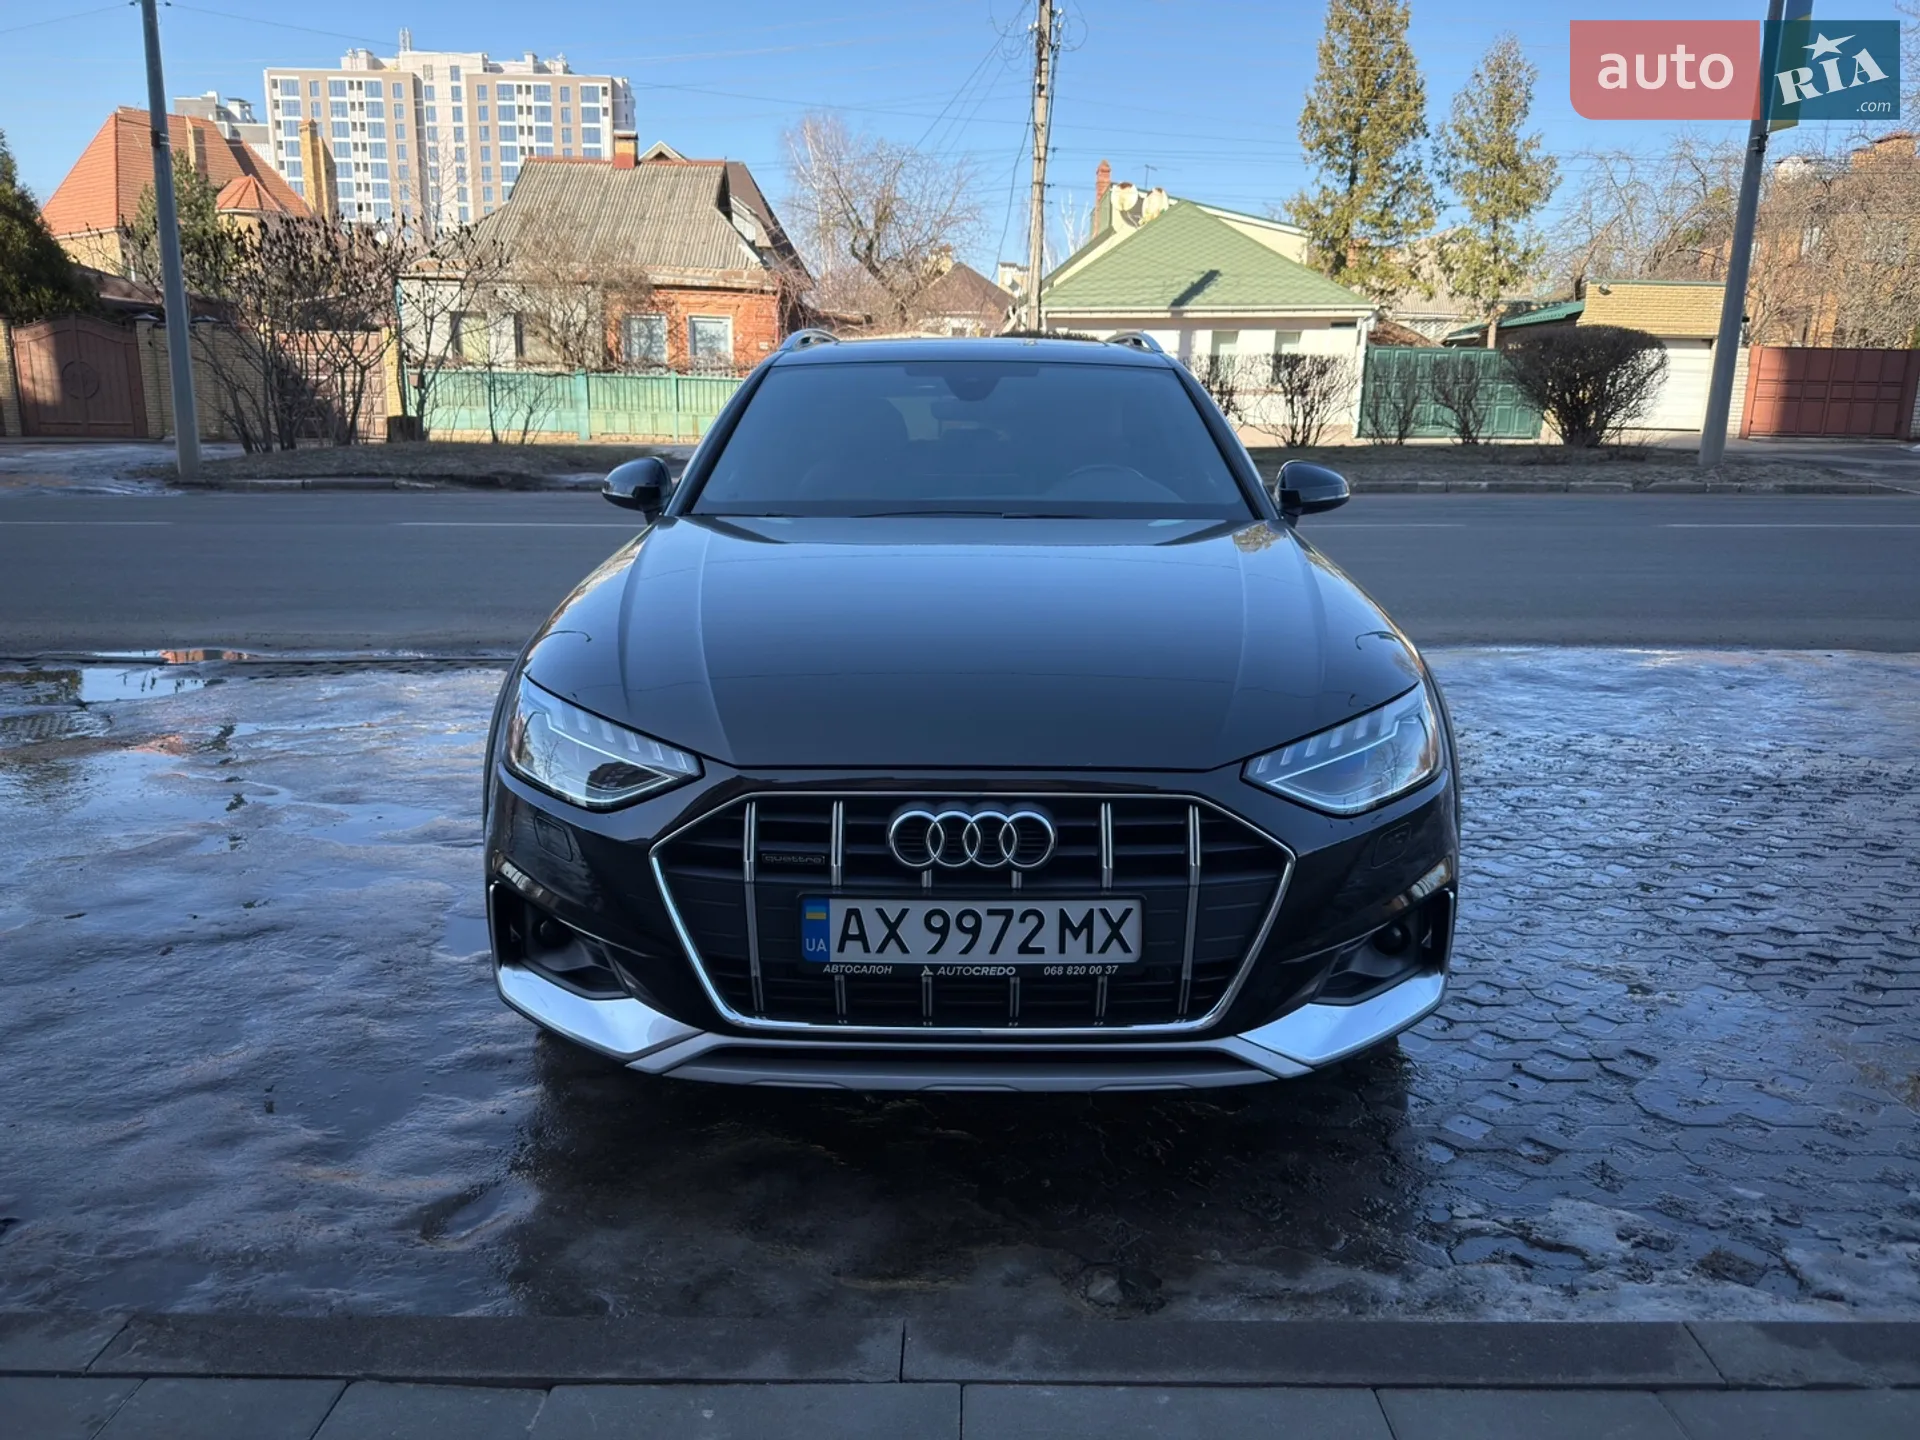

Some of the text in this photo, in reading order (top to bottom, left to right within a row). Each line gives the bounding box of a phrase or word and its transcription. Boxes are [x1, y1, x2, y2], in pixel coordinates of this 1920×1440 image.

[836, 907, 1134, 955] AX 9972 MX
[805, 938, 827, 952] UA
[822, 964, 893, 975] АВТОСАЛОН
[936, 966, 1016, 976] AUTOCREDO
[1043, 965, 1119, 976] 068 820 00 37
